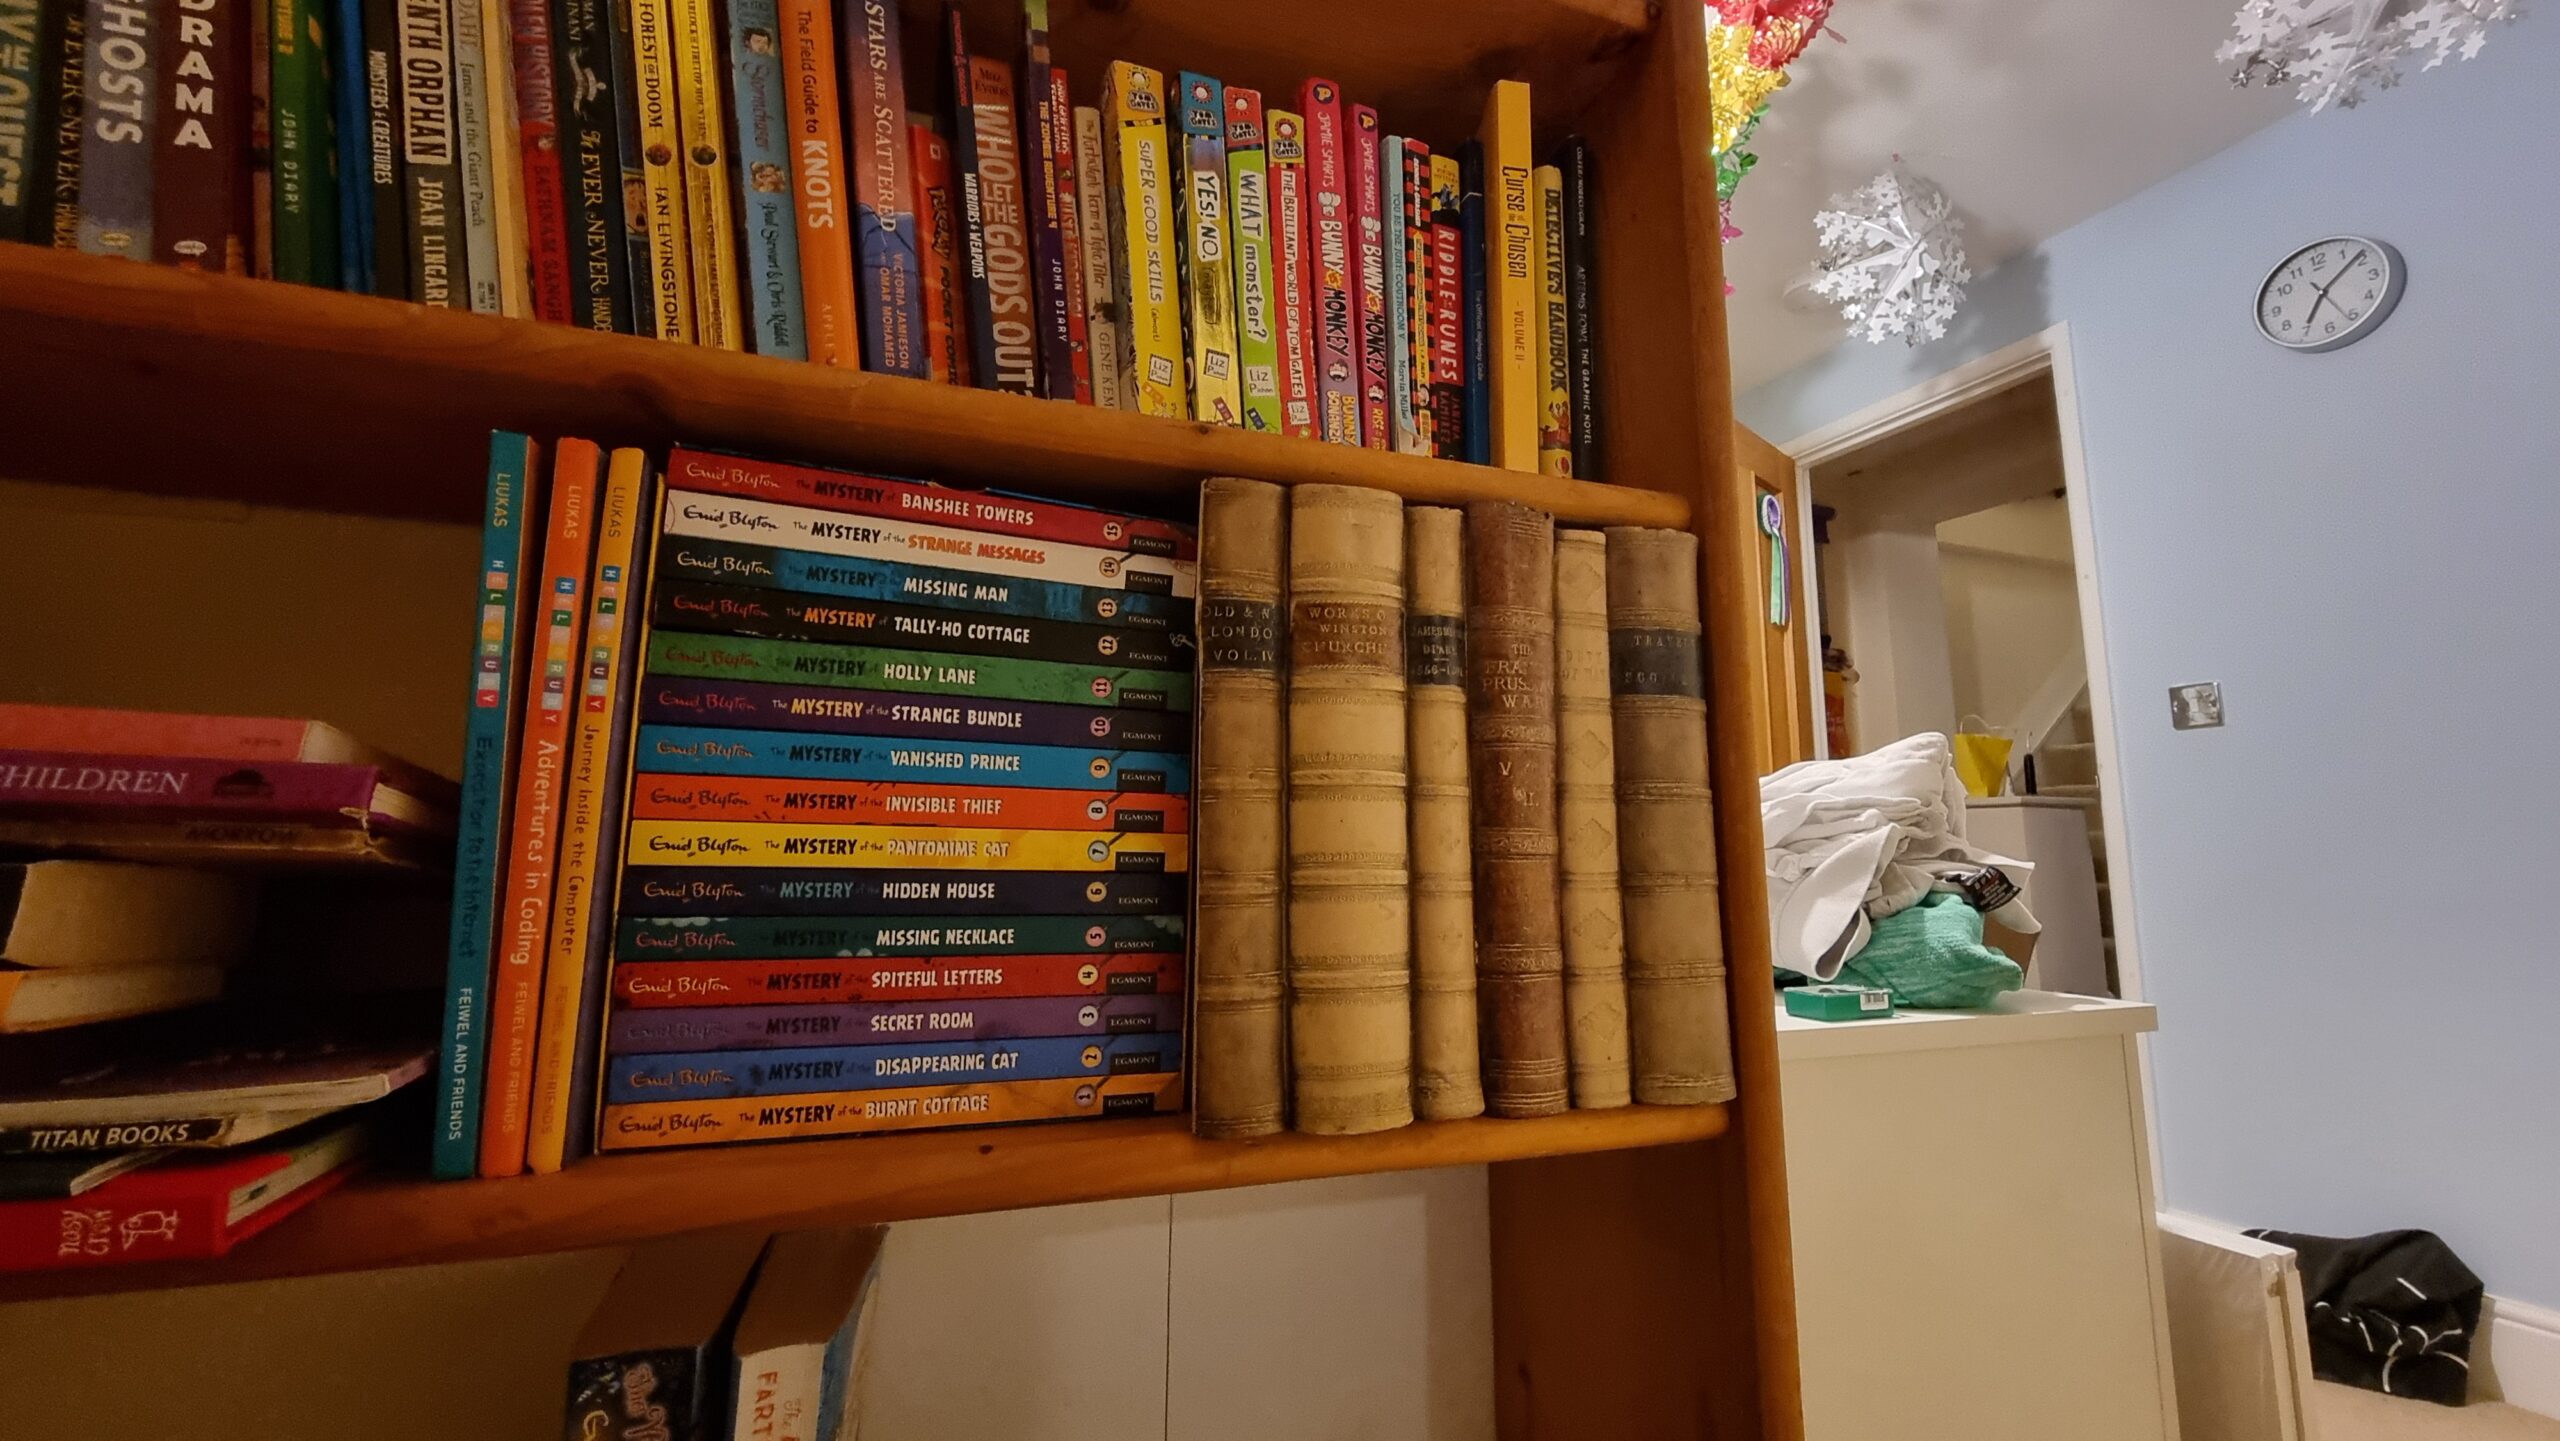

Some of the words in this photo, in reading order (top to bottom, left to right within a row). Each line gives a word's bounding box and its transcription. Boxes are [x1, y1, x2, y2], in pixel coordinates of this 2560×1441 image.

[638, 1, 658, 64] FOREST
[797, 10, 813, 30] The
[864, 0, 887, 71] STARS
[798, 35, 816, 71] Field
[368, 50, 389, 110] MONSTERS
[459, 62, 475, 98] James
[801, 75, 820, 107] Guide
[873, 74, 888, 101] ARE
[407, 58, 447, 158] ORPHAN
[464, 104, 477, 123] and
[645, 76, 663, 129] DOOM
[466, 127, 479, 149] the
[804, 112, 819, 133] to
[369, 121, 393, 185] CREATURES
[974, 104, 1016, 182] WHO
[1274, 147, 1299, 157] GATES
[1275, 140, 1295, 150] TOM
[467, 152, 483, 188] Giant
[581, 155, 603, 206] EVER
[872, 103, 898, 233] SCATTERED
[1139, 140, 1155, 188] SUPER
[418, 176, 445, 227] JOAN
[801, 139, 834, 230] KNOTS
[964, 172, 981, 224] WARRIORS
[982, 183, 1014, 203] LET
[1197, 173, 1220, 220] YES!
[1283, 172, 1295, 195] THE
[1502, 166, 1529, 211] Curse
[471, 191, 486, 227] Peach
[654, 188, 670, 216] IAN
[982, 203, 1019, 224] THE
[1141, 195, 1158, 243] GOOD
[1239, 174, 1262, 238] WHAT
[1199, 224, 1219, 260] NO.
[1282, 197, 1297, 260] BRILLIANT
[1320, 220, 1345, 273] BUNNY
[584, 209, 609, 286] NEVER
[969, 232, 986, 280] WEAPONS
[1438, 229, 1457, 299] RIDDLE
[1504, 224, 1531, 280] Chosen
[2309, 252, 2327, 267] 12
[2339, 249, 2347, 260] 1
[2357, 254, 2368, 267] 2
[657, 221, 680, 338] LIVINGSTONE
[892, 254, 907, 307] VICTORIA
[984, 224, 1027, 314] GODS
[1051, 258, 1066, 294] JOHN
[1146, 250, 1162, 302] SKILLS
[1285, 261, 1298, 305] WORLD
[1363, 241, 1383, 300] BUNNY
[2289, 266, 2304, 280] 11
[2368, 268, 2380, 281] 3
[879, 267, 895, 311] OMAR
[1244, 244, 1269, 340] monster?
[1576, 266, 1588, 310] ARTEMIS
[2276, 284, 2293, 297] 10
[2364, 289, 2374, 300] 4
[1054, 300, 1068, 343] DIARY
[1323, 289, 1350, 358] MONKEY
[2272, 306, 2282, 317] 9
[2282, 319, 2292, 331] 8
[2324, 321, 2336, 334] 6
[2349, 308, 2360, 321] 5
[880, 315, 897, 368] MOHAMED
[895, 310, 911, 371] JAMIESON
[1288, 320, 1302, 355] TOM
[1364, 309, 1387, 383] MONKEY
[1440, 309, 1458, 381] RUNES
[1548, 299, 1568, 393] HANDBOOK
[2301, 325, 2311, 337] 7
[1582, 347, 1590, 366] THE
[1250, 369, 1269, 382] Liz
[1290, 359, 1304, 397] GATES
[1582, 367, 1592, 412] GRAPHIC
[1327, 390, 1343, 444] BONANZA
[1342, 395, 1357, 446] BUNNY
[1584, 413, 1593, 445] NOVEL
[492, 473, 511, 528] LIUKAS
[564, 484, 583, 540] LIUKAS
[608, 485, 627, 539] LIUKAS
[683, 504, 725, 523] Enid
[728, 510, 780, 533] Blyton
[902, 493, 970, 518] BANSHEE
[975, 504, 1034, 526] TOWERS
[794, 520, 808, 531] The
[811, 521, 881, 544] MYSTERY
[893, 534, 906, 544] the
[907, 534, 972, 556] STRANGE
[976, 543, 1046, 565] MESSAGES
[1103, 561, 1116, 575] 14
[1129, 573, 1170, 586] EGMONT
[903, 576, 968, 599] MISSING
[974, 585, 1008, 603] MAN
[804, 607, 877, 629] MYSTERY
[894, 616, 962, 638] TALLY-HO
[967, 623, 1030, 644] COTTAGE
[1308, 607, 1370, 618] WORKS
[1319, 625, 1387, 636] WINSTON
[884, 664, 932, 681] HOLLY
[938, 667, 977, 685] LANE
[892, 705, 960, 724] STRANGE
[967, 709, 1022, 729] BUNDLE
[578, 724, 601, 783] Journey
[890, 750, 964, 769] VANISHED
[970, 754, 1021, 772] PRINCE
[0, 765, 189, 794] HILDREN
[528, 738, 560, 864] Adventures
[574, 788, 593, 835] Inside
[886, 797, 957, 814] INVISIBLE
[963, 799, 1002, 816] THIEF
[571, 841, 585, 868] the
[650, 836, 691, 852] Enid
[697, 837, 750, 854] Blyton
[765, 840, 780, 850] The
[784, 838, 858, 855] MYSTERY
[870, 841, 884, 851] the
[888, 840, 977, 857] PANTOMIME
[983, 842, 1010, 857] CAT
[1092, 847, 1105, 856] 7
[1119, 855, 1160, 864] EGMONT
[524, 872, 547, 892] in
[883, 883, 940, 899] HIDDEN
[947, 882, 996, 898] HOUSE
[510, 894, 543, 966] Coding
[560, 874, 585, 956] Computer
[876, 929, 940, 946] MISSING
[945, 929, 1015, 945] NECKLACE
[629, 978, 671, 994] Enid
[678, 977, 731, 996] Blyton
[872, 970, 938, 988] SPITEFUL
[943, 969, 1003, 986] LETTERS
[455, 986, 472, 1041] FEIWEL
[871, 1014, 924, 1032] SECRET
[929, 1012, 974, 1030] ROOM
[452, 1044, 469, 1073] AND
[875, 1055, 985, 1076] DISAPPEARING
[991, 1052, 1019, 1070] CAT
[447, 1076, 466, 1142] FRIENDS
[759, 1104, 835, 1125] MYSTERY
[865, 1099, 917, 1119] BURNT
[923, 1095, 989, 1115] COTTAGE
[31, 1128, 99, 1149] TITAN
[105, 1123, 190, 1145] BOOKS
[752, 1371, 779, 1436] FART
